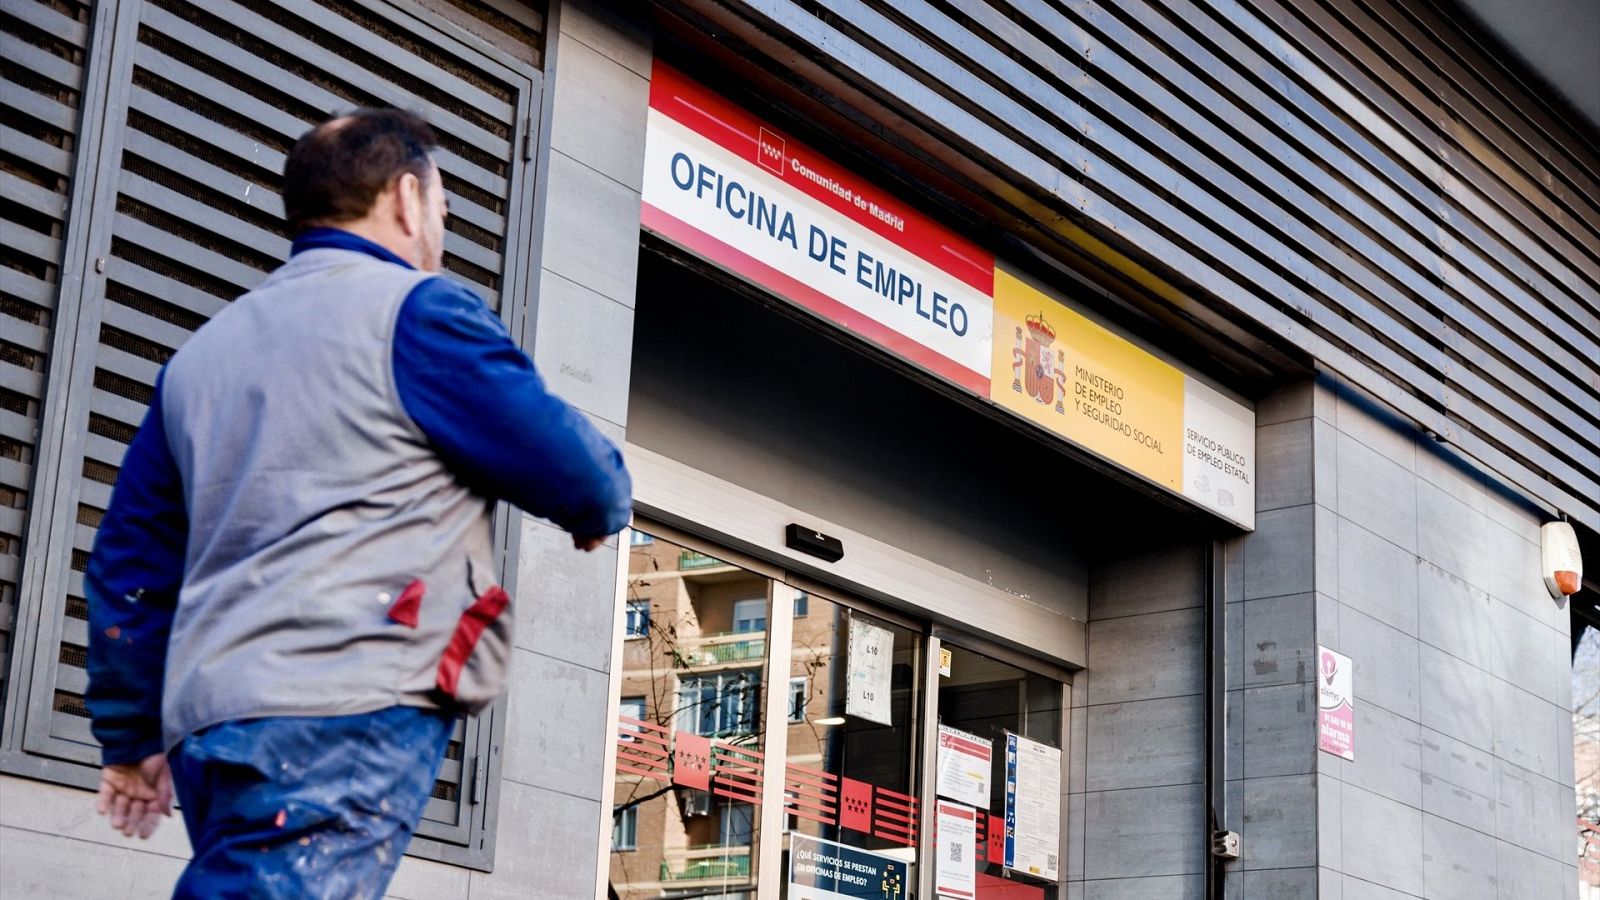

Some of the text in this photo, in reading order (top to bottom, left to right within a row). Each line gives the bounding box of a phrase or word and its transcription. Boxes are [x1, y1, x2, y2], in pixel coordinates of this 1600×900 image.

[791, 158, 904, 232] Comunidad de Madrid
[670, 152, 968, 337] OFICINA DE EMPLEO
[1075, 365, 1124, 400] MINISTERIO
[1075, 382, 1122, 415] DE EMPLEO
[1074, 398, 1164, 454] Y SEGURIDAD SOCIAL
[1186, 443, 1250, 485] DE EMPLEO ESTATAL
[1187, 428, 1246, 467] SERVICIO PÚBLICO
[866, 644, 878, 656] L10
[862, 690, 875, 702] L10
[1320, 724, 1350, 744] alarma
[796, 849, 877, 876] ¿QUÉ SERVICIOS SE PRESTAN
[796, 863, 868, 887] EN OFICINAS DE EMPLEO?
